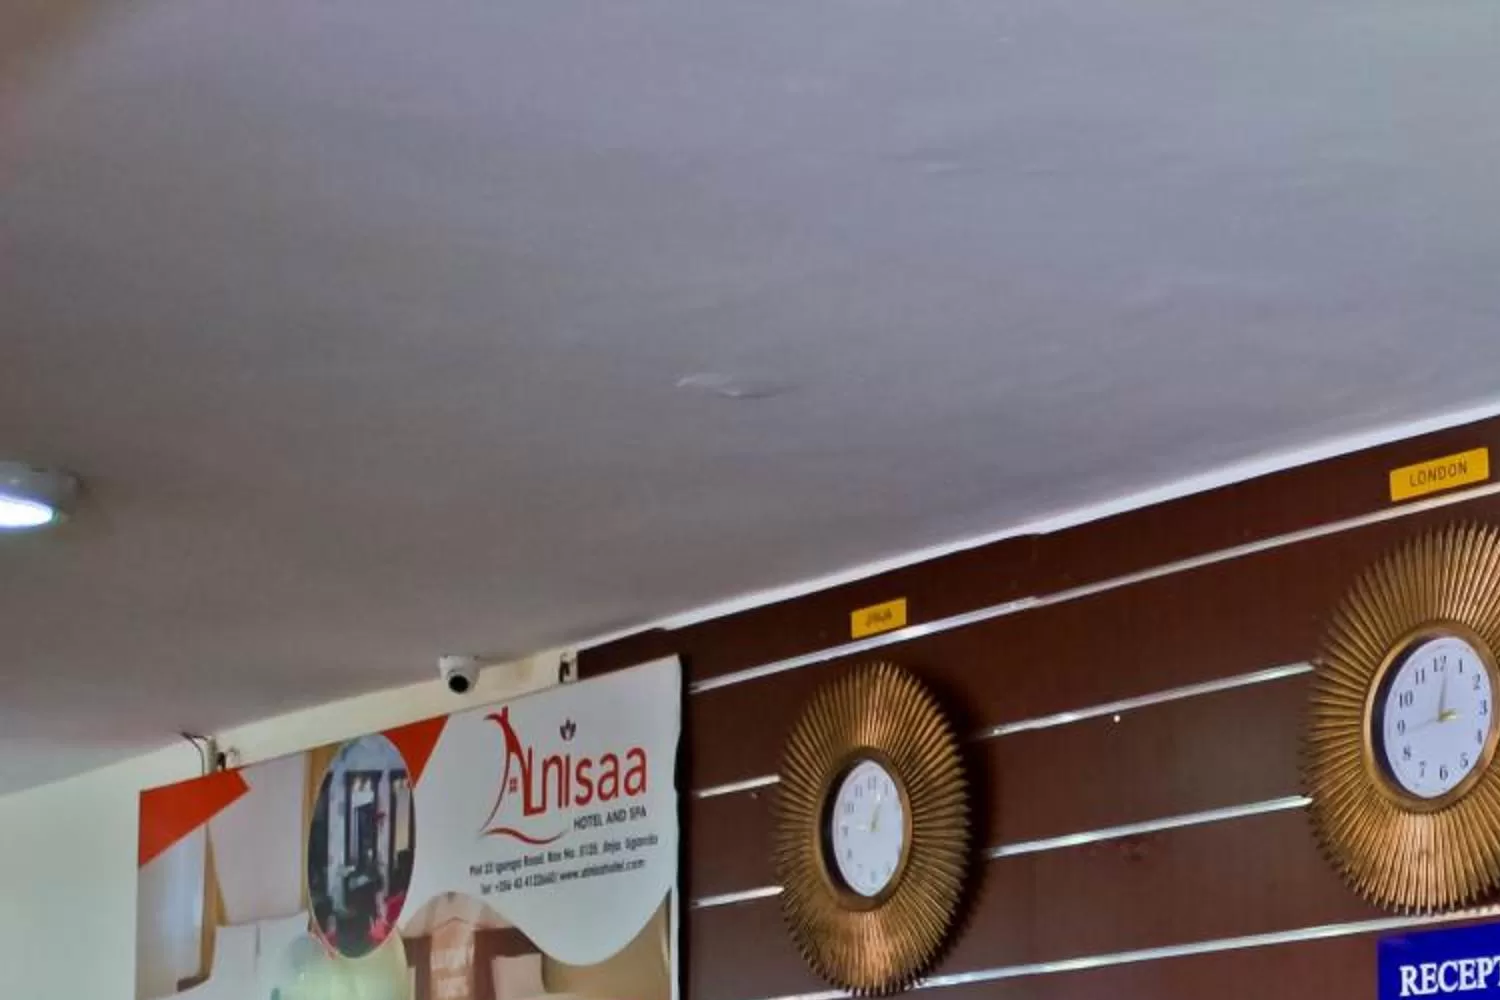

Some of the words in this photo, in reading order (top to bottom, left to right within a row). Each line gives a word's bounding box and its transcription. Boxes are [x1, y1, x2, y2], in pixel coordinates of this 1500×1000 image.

[1409, 456, 1468, 488] LONDON
[1432, 655, 1447, 674] 12
[1413, 667, 1425, 686] 11
[1472, 673, 1481, 691] 2
[1399, 691, 1413, 709] 10
[1478, 699, 1487, 716] 3
[1396, 719, 1406, 737] 9
[1474, 727, 1483, 745] 4
[1402, 743, 1412, 761] 8
[1460, 752, 1469, 769] 5
[1417, 760, 1427, 778] 7
[1438, 763, 1449, 780] 6
[573, 812, 603, 830] HOTEL
[605, 808, 627, 825] AND
[629, 804, 647, 821] SPA
